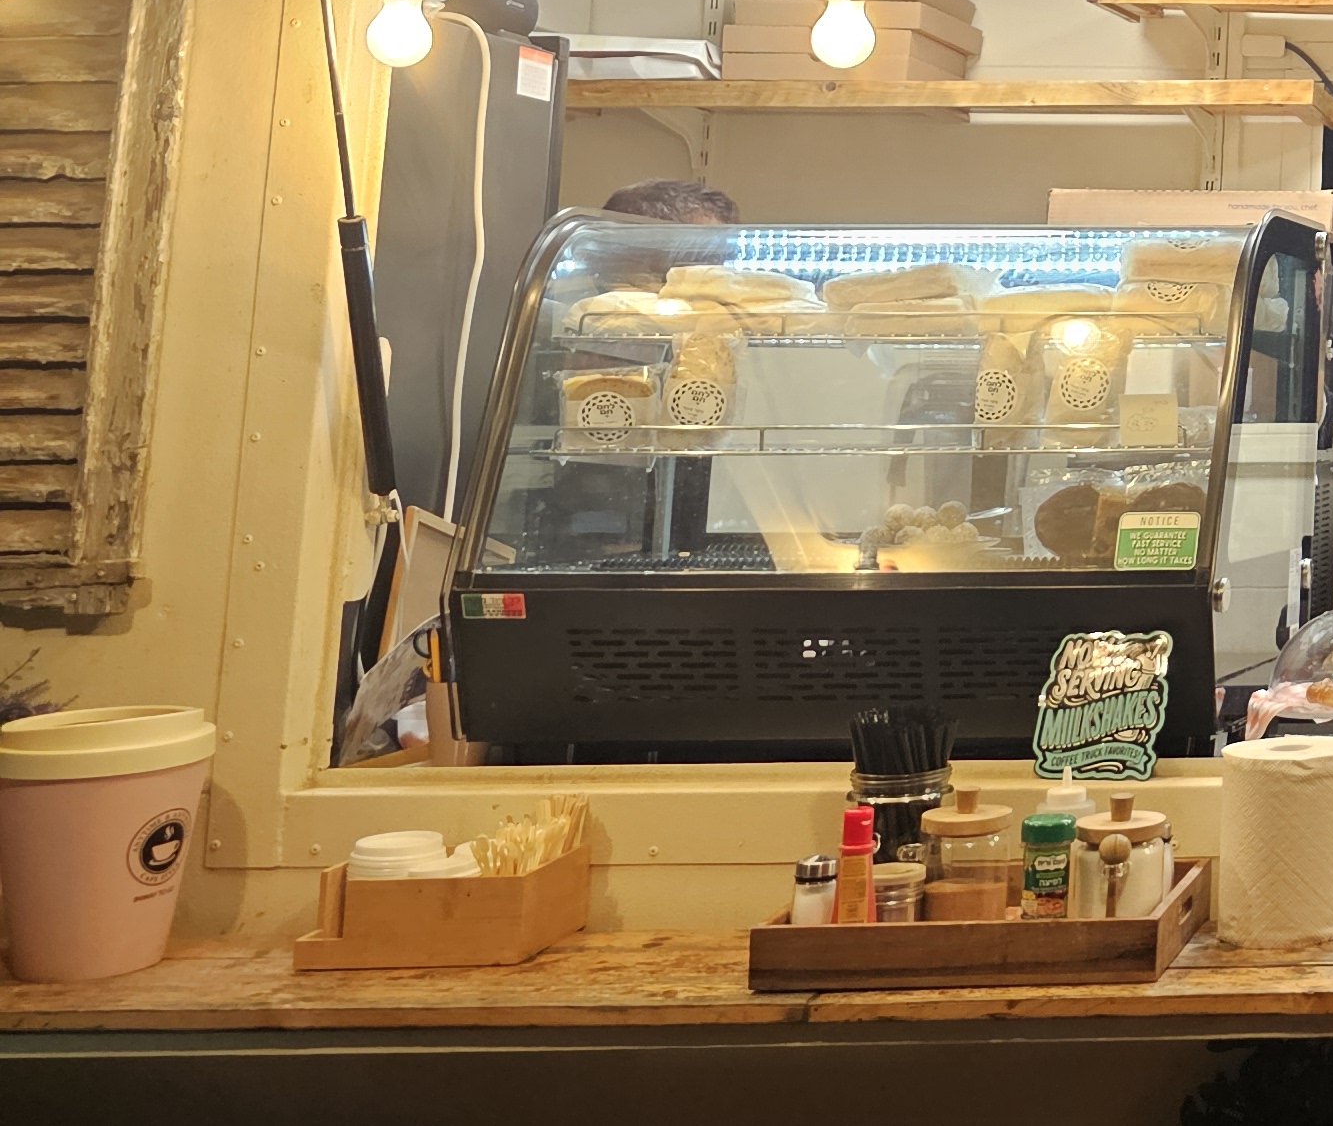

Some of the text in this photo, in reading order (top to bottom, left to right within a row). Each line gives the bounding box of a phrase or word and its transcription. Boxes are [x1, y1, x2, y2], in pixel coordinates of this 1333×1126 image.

[1140, 516, 1180, 526] NOTICE
[1143, 531, 1187, 539] GUARANTEE
[1131, 540, 1182, 548] FAST SERVICE
[1134, 548, 1145, 556] NO
[1118, 556, 1193, 565] HOW LONG IT TAKES
[1051, 661, 1142, 700] SERVING
[1051, 754, 1079, 767] COFFEE
[1081, 748, 1103, 761] TRUCK
